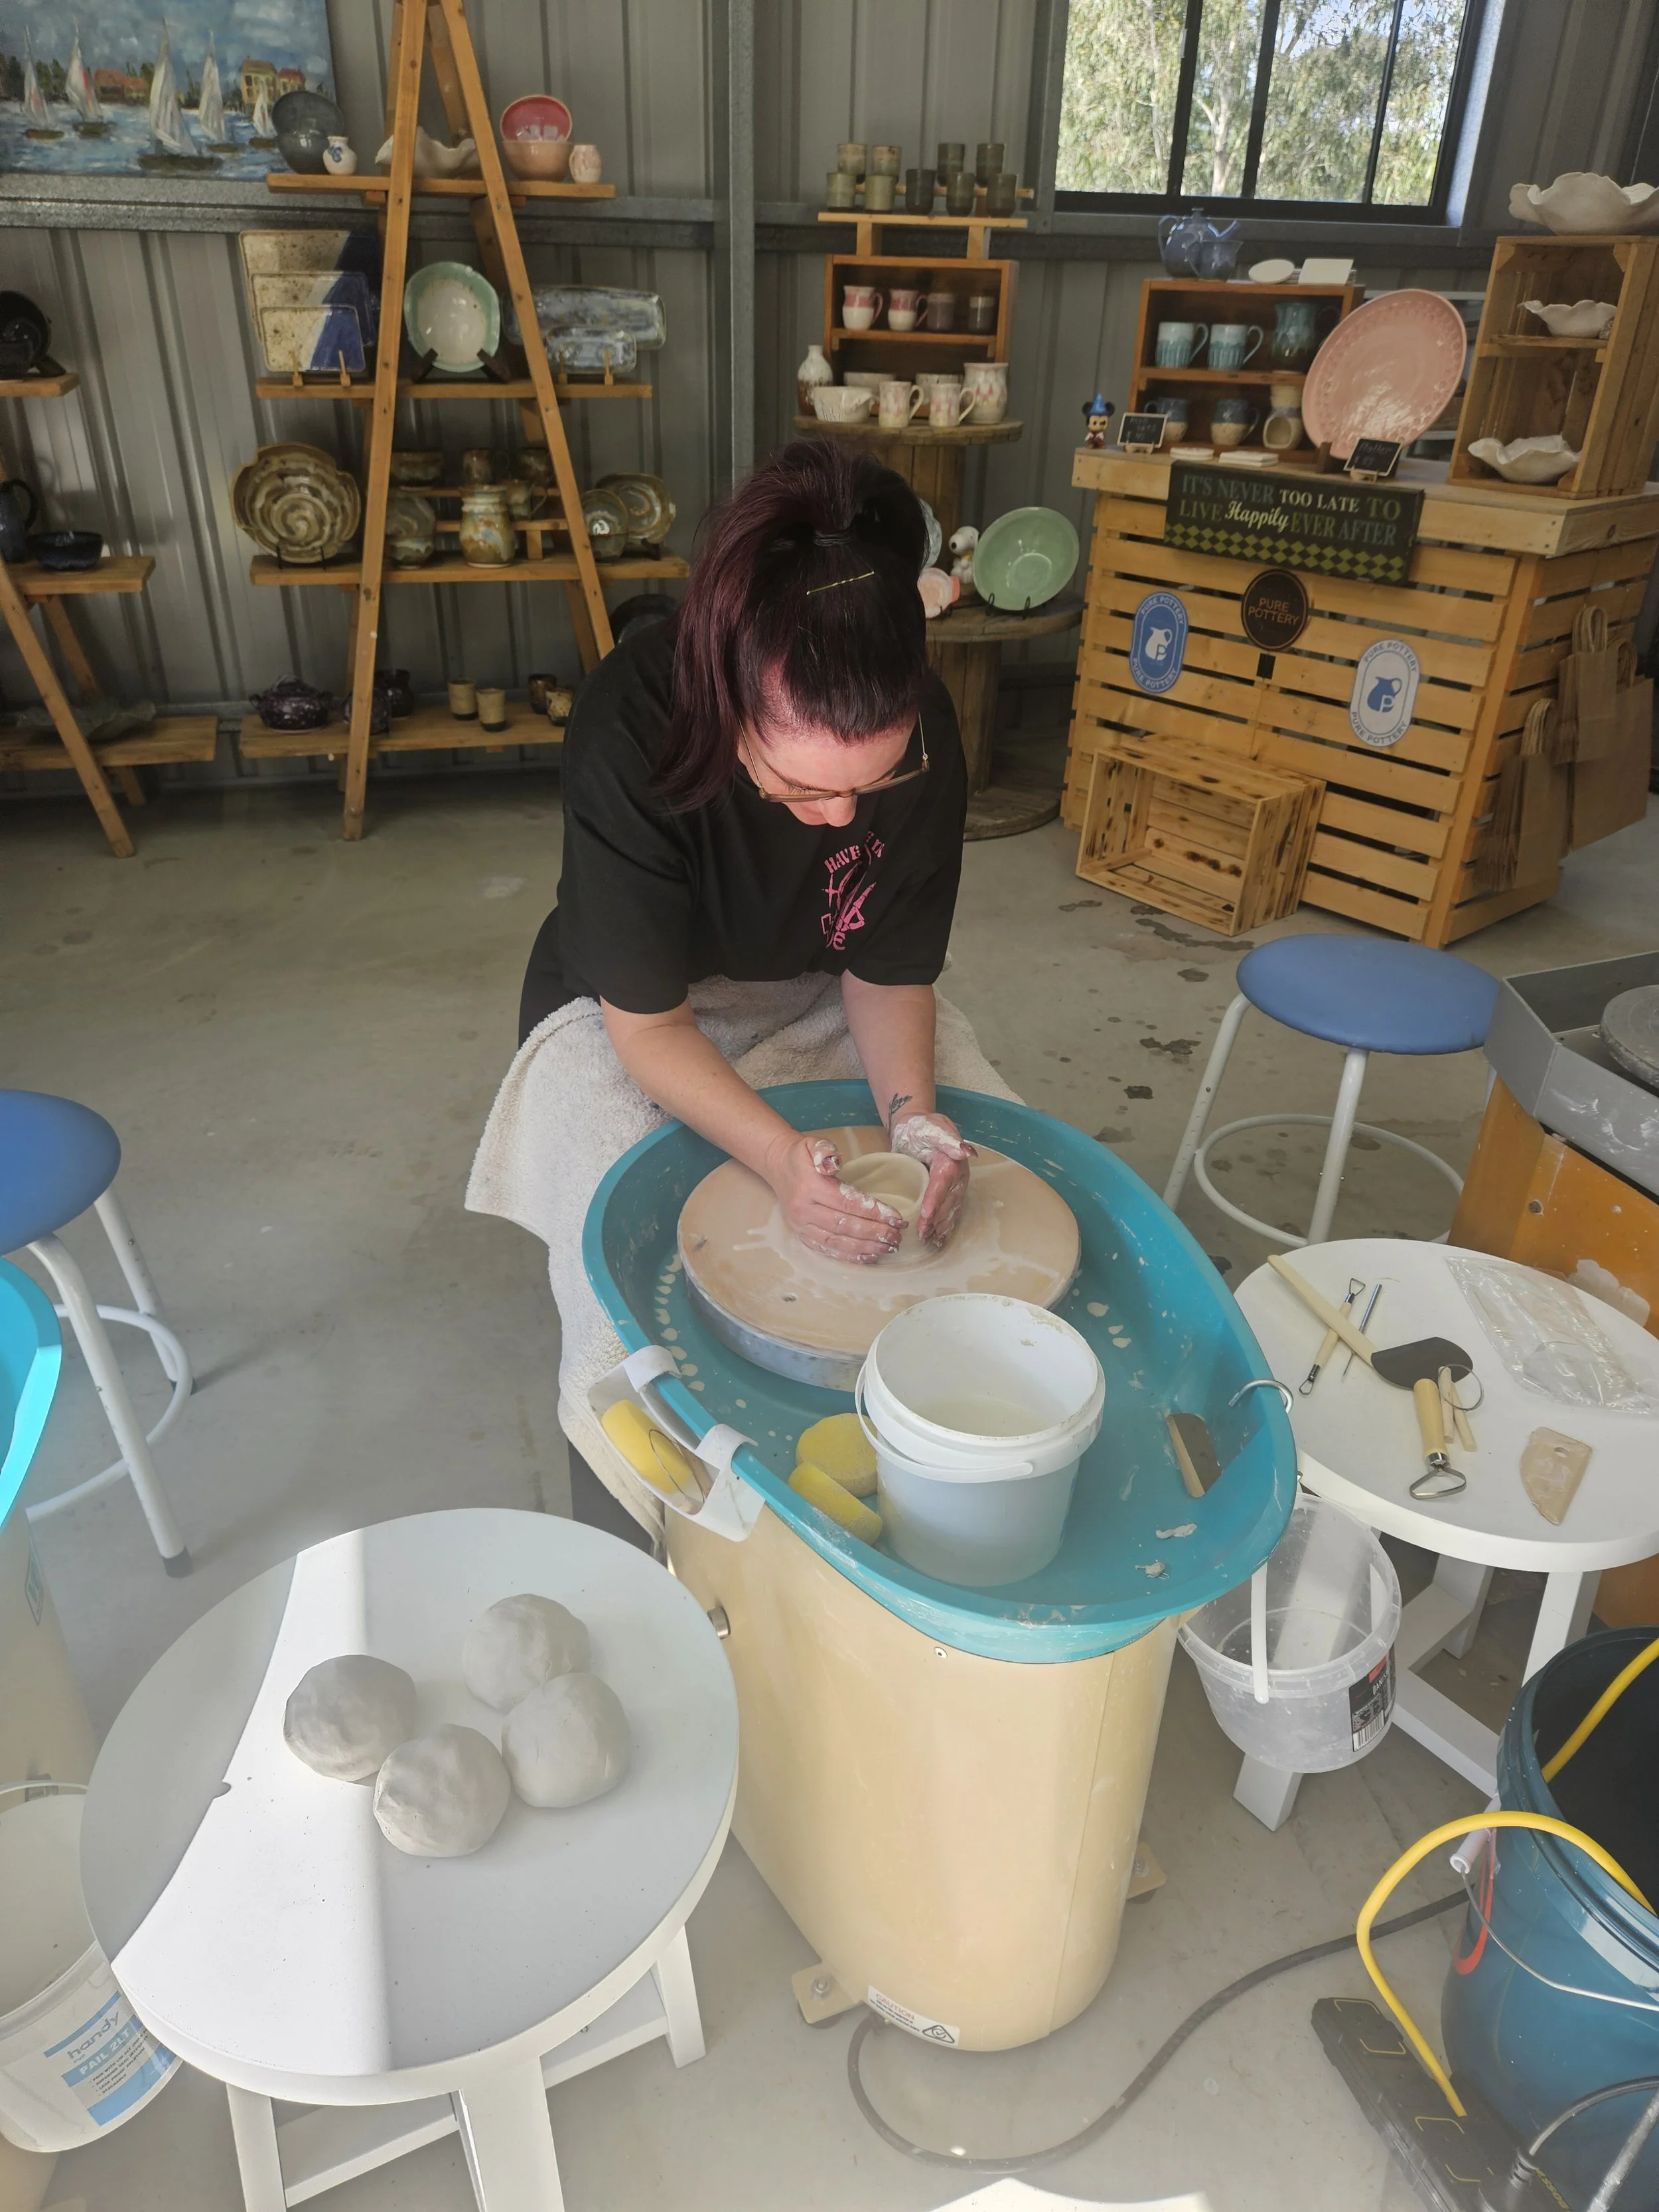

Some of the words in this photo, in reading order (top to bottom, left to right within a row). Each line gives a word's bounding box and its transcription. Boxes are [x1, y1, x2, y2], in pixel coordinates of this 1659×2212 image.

[1182, 474, 1212, 496] IT'S
[1217, 480, 1274, 504] NEVER
[1279, 488, 1313, 508] TOO
[1317, 493, 1360, 514] LATE
[1366, 496, 1402, 520] TO
[1179, 499, 1223, 522] LIVE
[1225, 500, 1290, 533] Happily
[1291, 512, 1336, 538] EVER
[1338, 521, 1397, 546] AFTER
[1141, 597, 1158, 615] PURE
[1160, 596, 1184, 625] POTTERY
[1248, 606, 1299, 626] POTTERY
[1259, 597, 1290, 613] PURE
[1364, 642, 1384, 663] PURE
[1388, 641, 1417, 672] POTTERY
[1133, 658, 1144, 683] PURE
[1145, 667, 1176, 688] POTTERY
[1351, 711, 1365, 737] PURE
[1367, 721, 1407, 744] POTTERY
[824, 845, 861, 874] HAVE
[876, 1994, 915, 2020] CAUTION
[67, 2012, 119, 2059] handy
[79, 2053, 109, 2075] PAIL
[109, 2028, 129, 2052] 2LT
